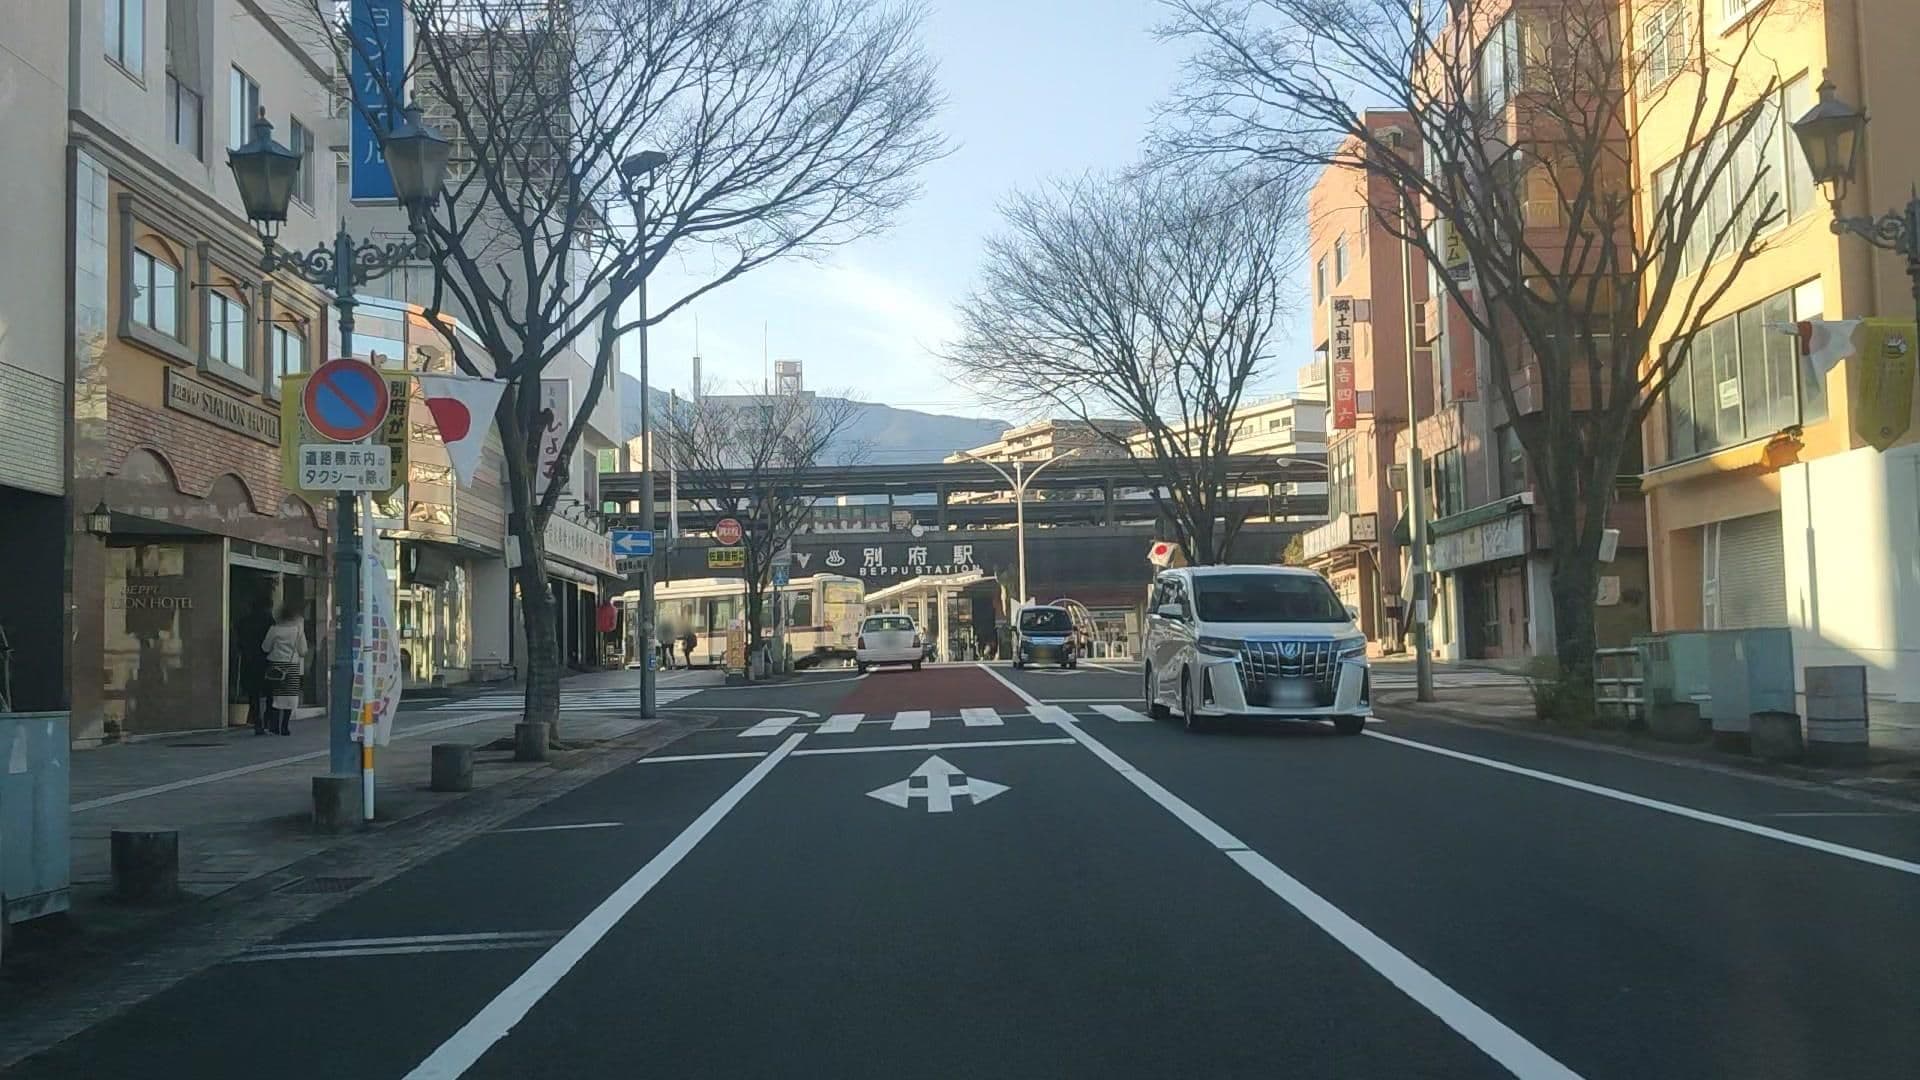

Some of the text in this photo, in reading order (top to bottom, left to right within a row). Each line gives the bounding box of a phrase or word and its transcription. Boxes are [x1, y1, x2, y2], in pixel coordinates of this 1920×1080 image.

[1334, 299, 1351, 360] 郷土料理
[1336, 367, 1353, 422] 吉四六
[202, 393, 245, 426] STATION
[248, 411, 276, 439] HOTEL
[860, 563, 982, 576] BEPPU STATION
[863, 545, 974, 567] 別府駅
[150, 597, 193, 609] HOTEL
